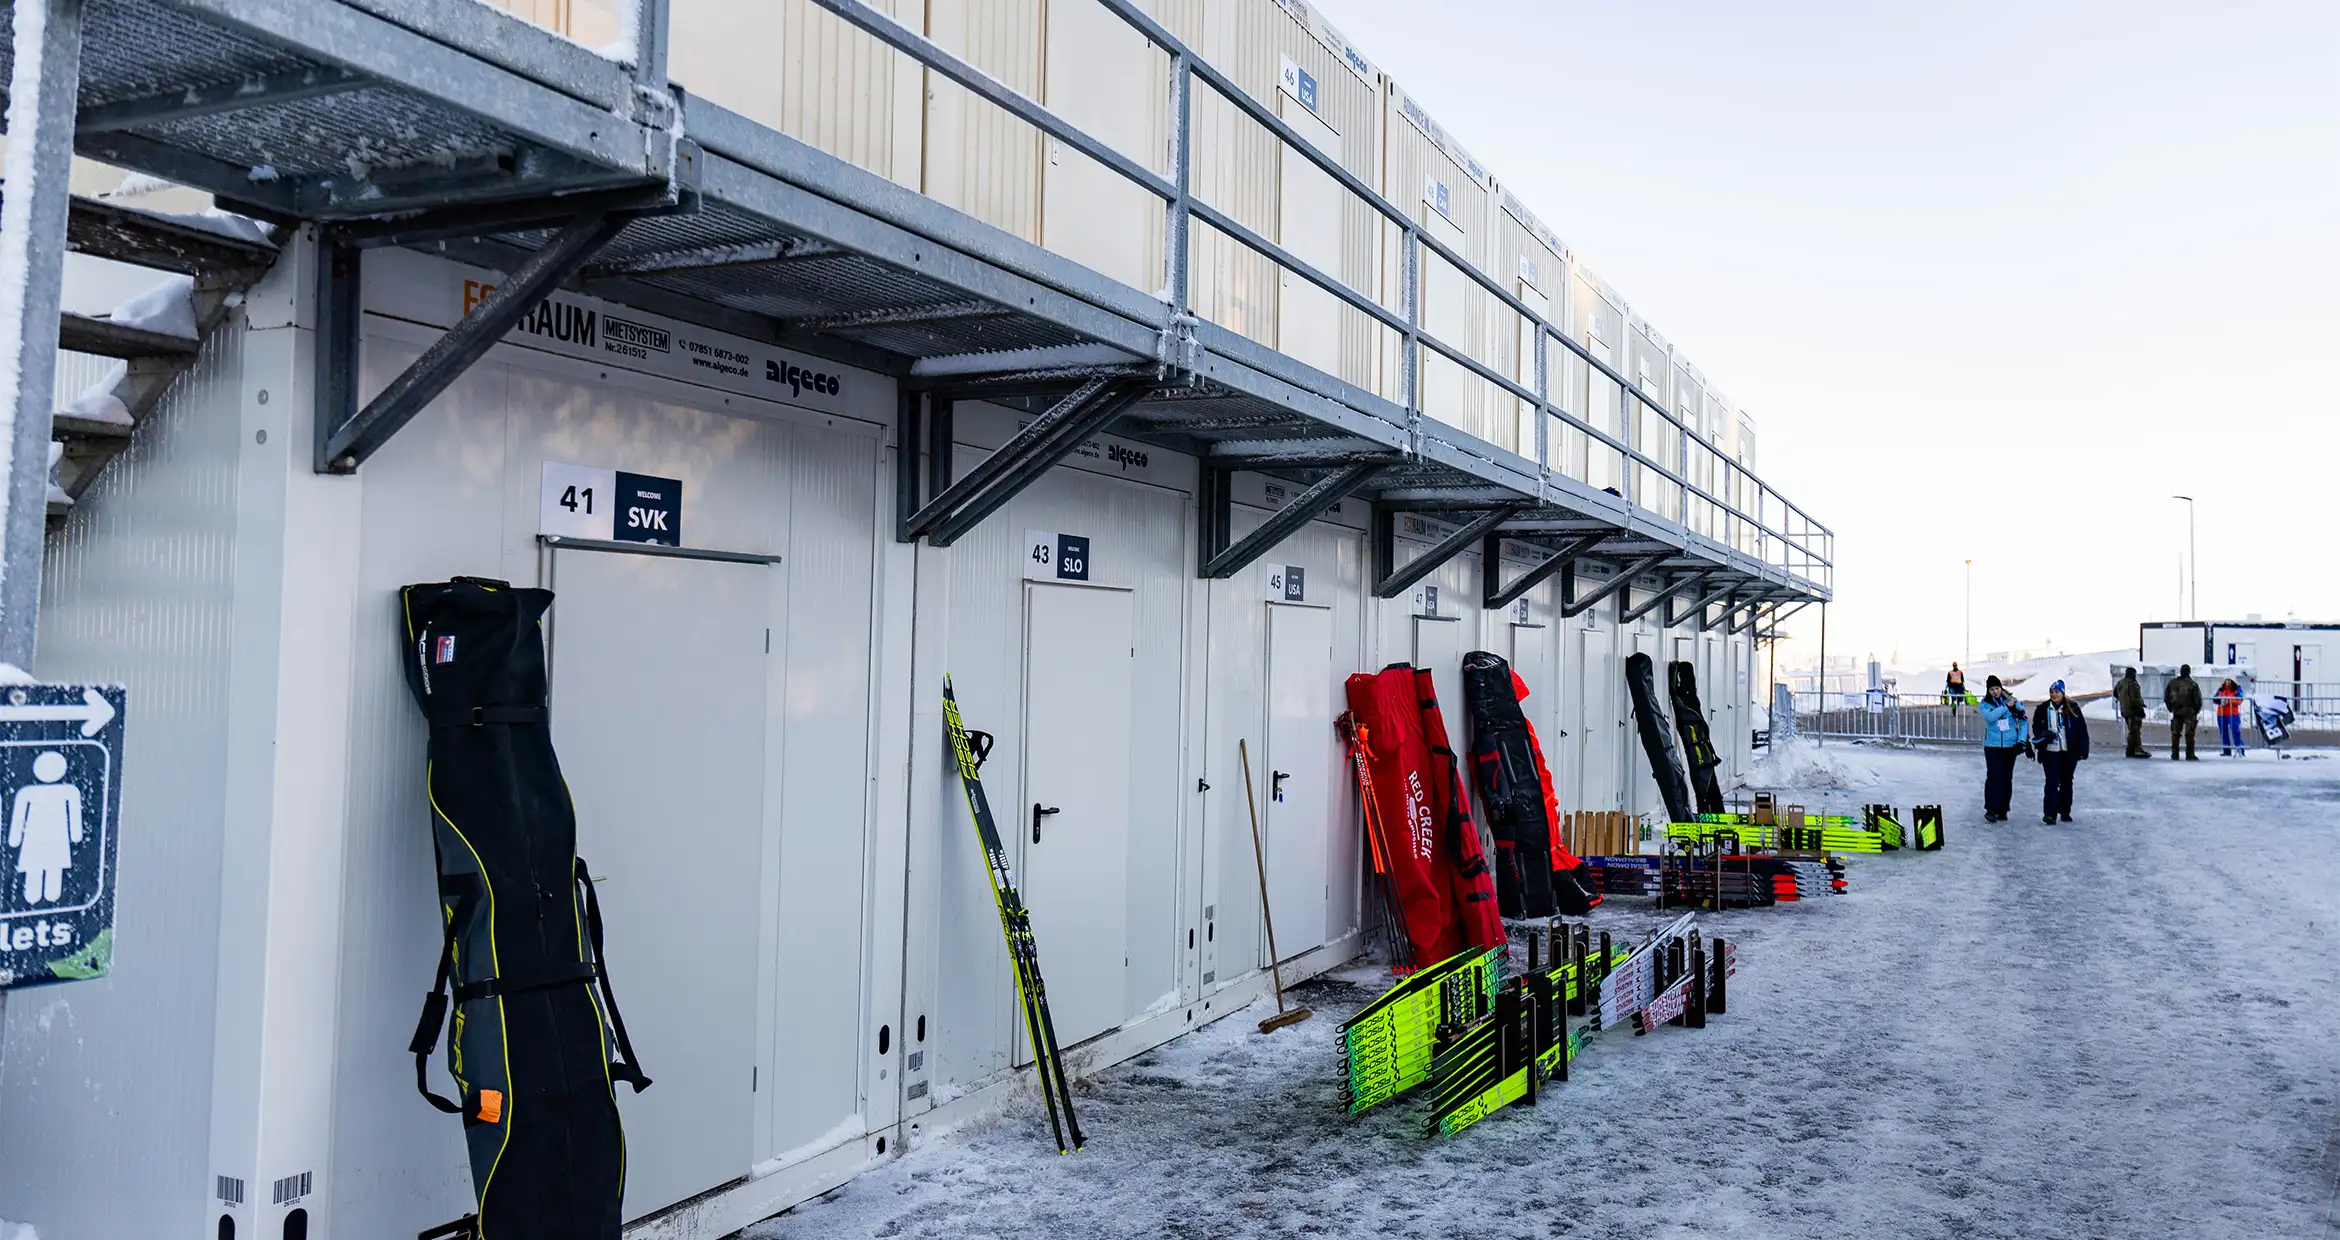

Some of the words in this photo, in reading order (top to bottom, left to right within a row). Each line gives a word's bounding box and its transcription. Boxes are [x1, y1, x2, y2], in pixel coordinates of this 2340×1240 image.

[1284, 68, 1295, 87] 46
[605, 319, 668, 350] MIETSYSTEM
[692, 357, 749, 377] www.algeco.de
[714, 349, 749, 365] 6873-002
[766, 359, 840, 398] algeco
[1108, 444, 1148, 471] algeco
[560, 485, 593, 514] 41
[636, 490, 662, 500] WELCOME
[628, 506, 668, 531] SVK
[1032, 544, 1050, 564] 43
[1064, 557, 1083, 573] SLO
[1270, 574, 1281, 589] 45
[1288, 584, 1301, 595] USA
[942, 697, 971, 780] FISCHER
[949, 699, 979, 781] FISCHER
[1408, 770, 1424, 802] RED
[1418, 805, 1433, 861] CREEK
[1351, 1023, 1385, 1046] FISCHER
[1352, 1013, 1385, 1036] FISCHER
[1354, 1033, 1387, 1056] FISCHER
[1354, 1043, 1387, 1066] FISCHER
[1355, 1054, 1389, 1076] FISCHER
[1355, 1065, 1389, 1087] FISCHER
[1359, 1075, 1392, 1097] FISCHER
[1353, 1089, 1388, 1112] FISCHER
